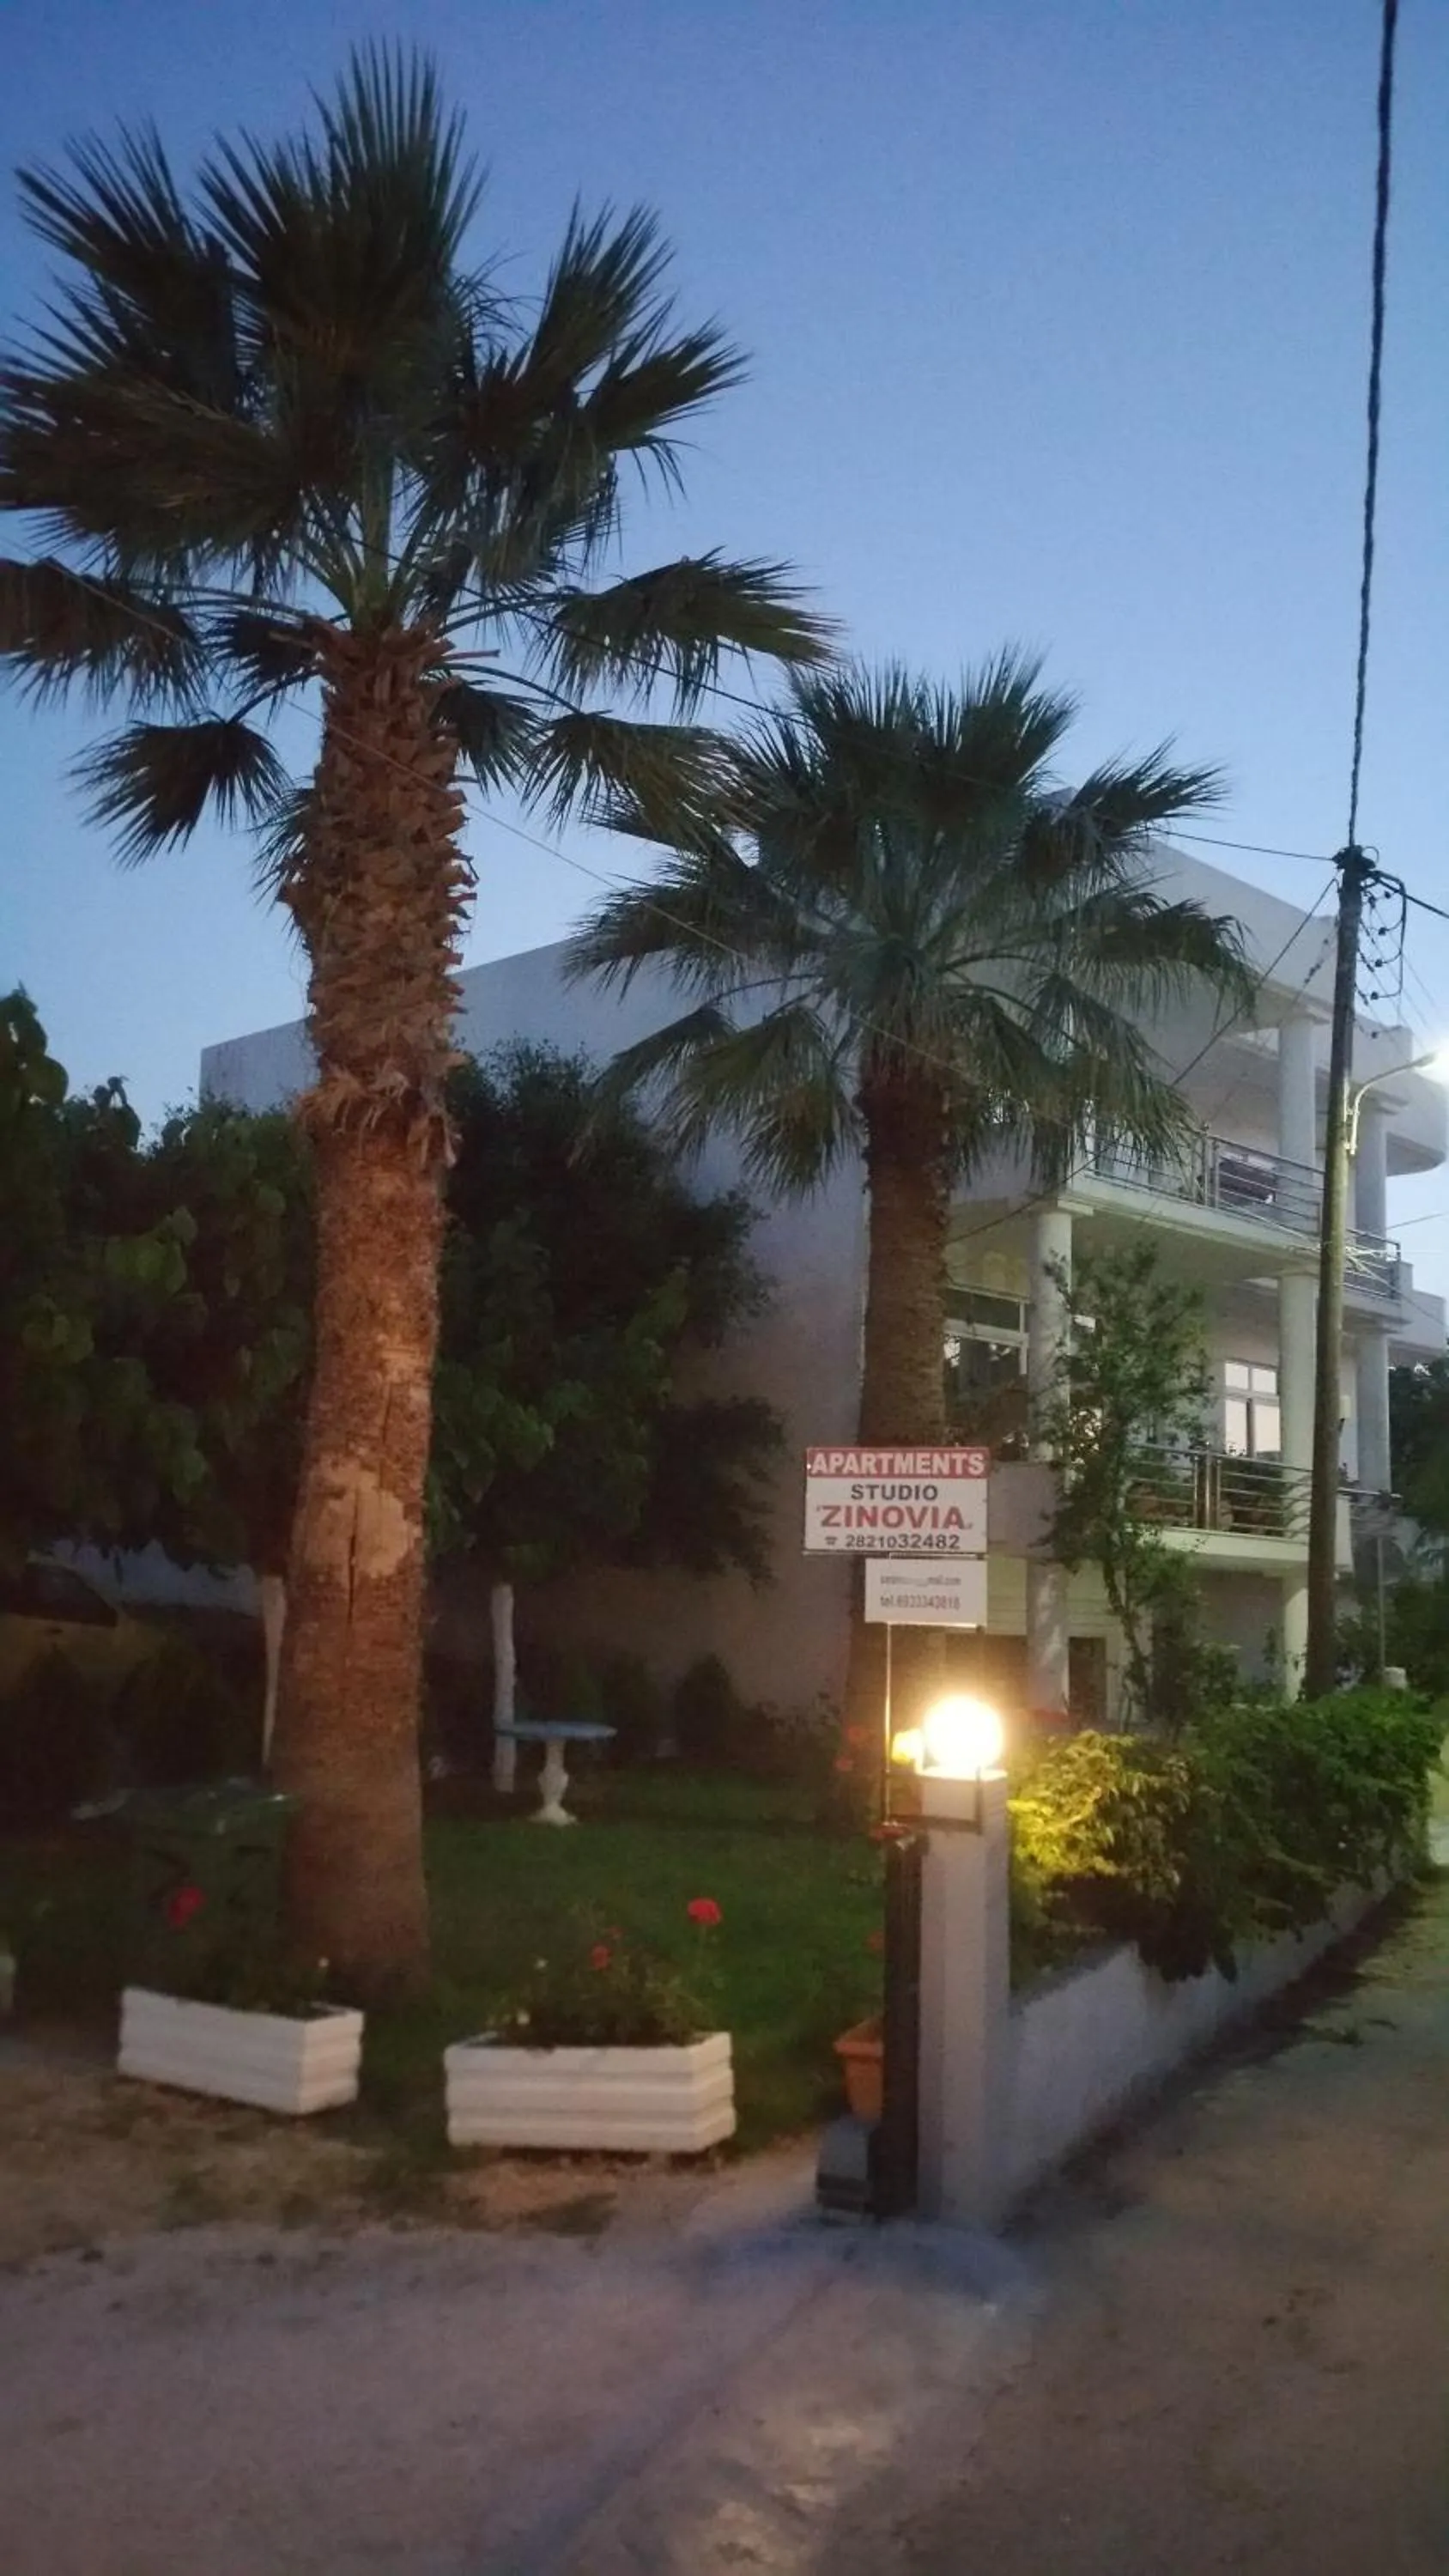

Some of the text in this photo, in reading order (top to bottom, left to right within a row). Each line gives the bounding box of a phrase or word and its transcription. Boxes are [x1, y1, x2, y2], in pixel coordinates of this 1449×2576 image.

[811, 1452, 985, 1475] APARTMENTS
[851, 1484, 938, 1501] STUDIO
[845, 1534, 961, 1550] 2821032482
